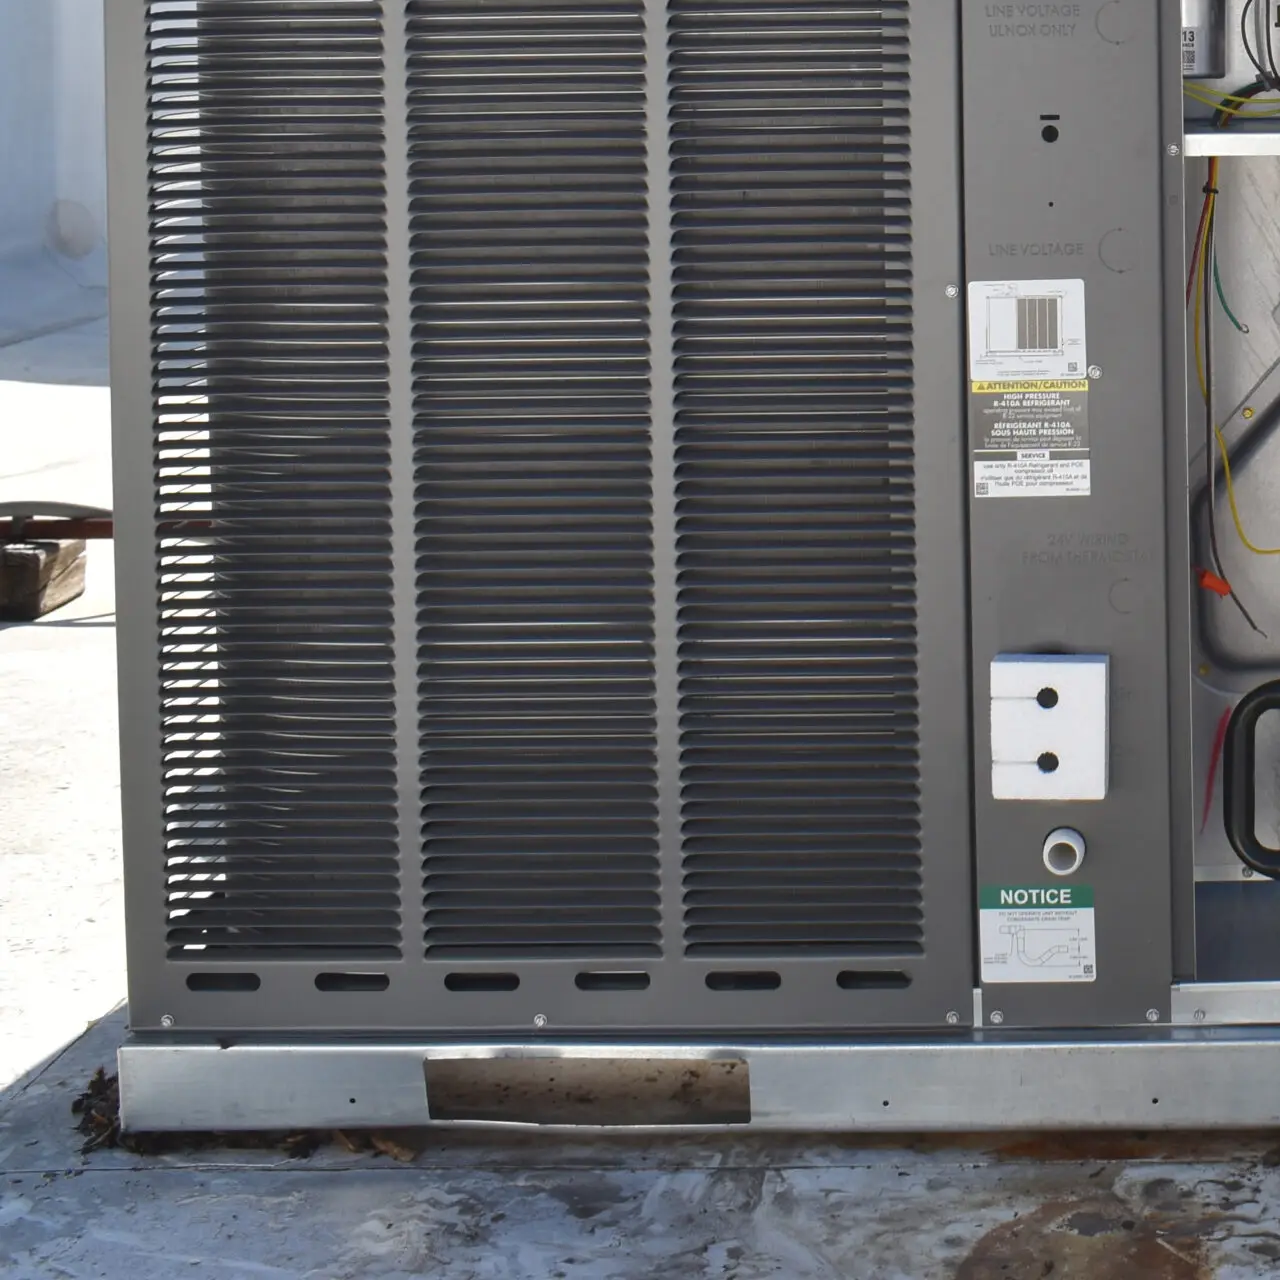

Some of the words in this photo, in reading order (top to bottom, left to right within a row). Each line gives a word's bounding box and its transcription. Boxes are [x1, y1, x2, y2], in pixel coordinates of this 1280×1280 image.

[985, 4, 1013, 18] LINE
[1015, 4, 1080, 17] VOLTAGE
[1040, 23, 1077, 37] ONLY
[988, 243, 1018, 256] LINE
[1020, 242, 1085, 257] VOLTAGE
[986, 381, 1086, 391] ATTENTION/CAUTION
[1000, 889, 1072, 904] NOTICE
